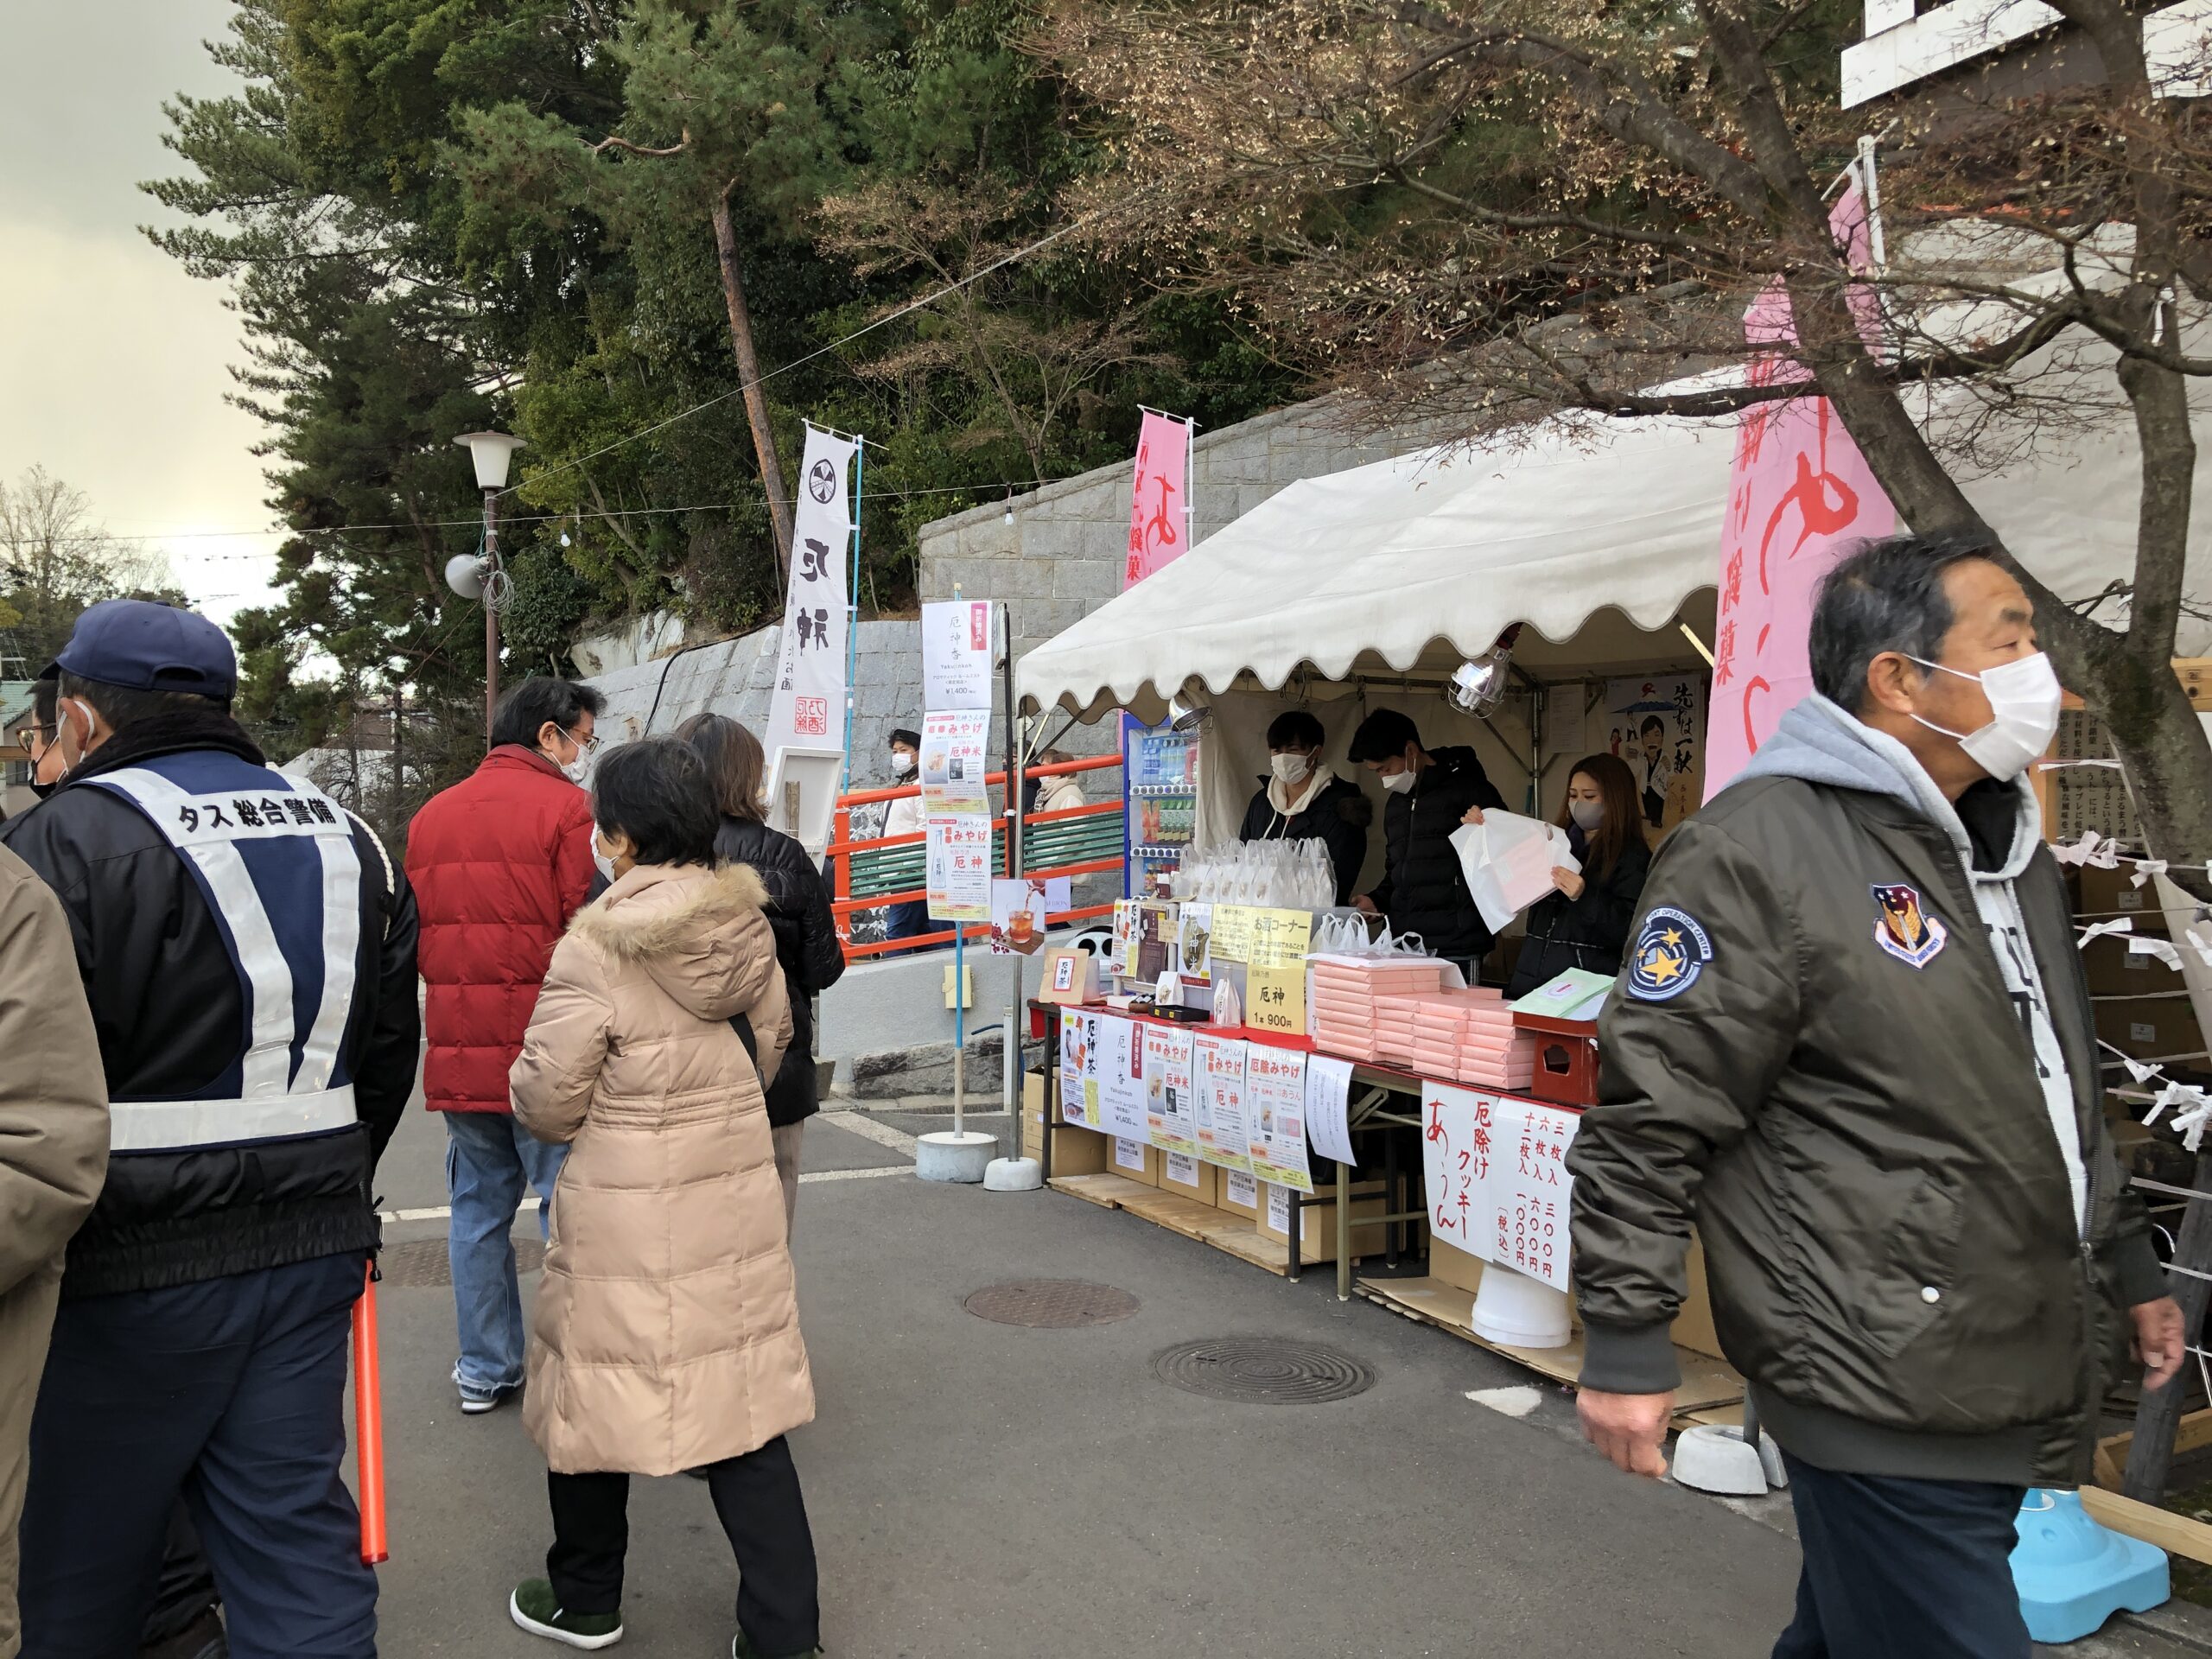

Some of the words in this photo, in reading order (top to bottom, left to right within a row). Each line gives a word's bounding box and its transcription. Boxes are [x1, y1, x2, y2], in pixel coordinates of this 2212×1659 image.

[178, 797, 338, 833] タス総合警備
[954, 856, 983, 870] 厄神
[1254, 917, 1308, 933] お酒コーナー
[1259, 986, 1285, 1007] 厄神
[1268, 1014, 1293, 1028] 900円
[1249, 1058, 1301, 1079] 厄除みやげ
[1216, 1089, 1239, 1109] 厄神
[1473, 1101, 1492, 1180] 厄除け
[1517, 1111, 1535, 1175] 十二枚入
[1532, 1116, 1550, 1181] 六枚入
[1548, 1122, 1565, 1186] 三枚入
[1457, 1149, 1471, 1241] クッキー
